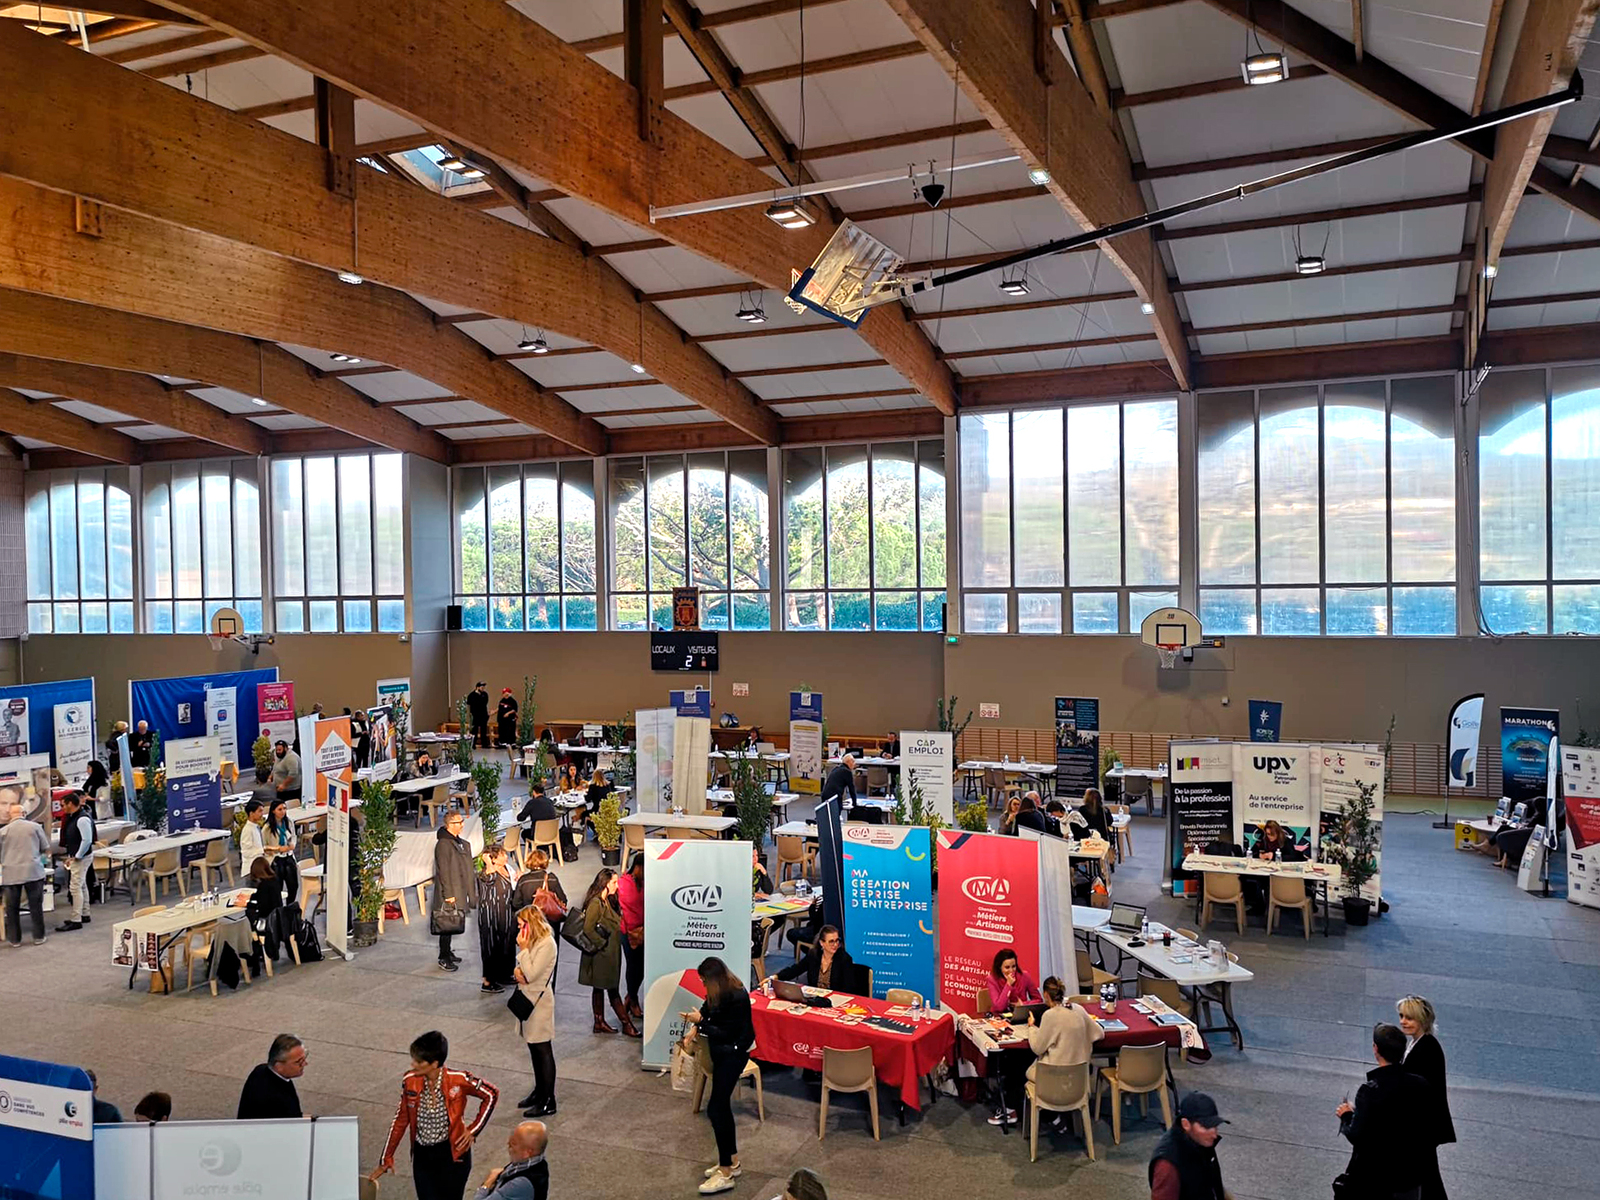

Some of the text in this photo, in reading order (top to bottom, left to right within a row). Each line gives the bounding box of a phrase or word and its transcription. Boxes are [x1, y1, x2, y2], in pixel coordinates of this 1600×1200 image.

[652, 645, 717, 654] LOCAUX VISITEURS
[685, 655, 693, 667] 2
[1504, 717, 1547, 726] MARATHON
[916, 739, 936, 747] CAP
[908, 747, 944, 755] EMPLOI
[1190, 788, 1212, 796] passion
[1181, 795, 1189, 803] la
[1190, 794, 1230, 804] profession
[1261, 802, 1304, 811] l'entreprise
[851, 869, 868, 878] MA
[851, 879, 910, 890] CREATION
[852, 889, 901, 899] REPRISE
[961, 876, 1012, 906] CMA
[670, 884, 724, 913] CMA
[852, 899, 927, 911] D'ENTREPRISE
[977, 912, 1007, 922] Métiers
[687, 921, 718, 929] Métiers
[976, 920, 1013, 932] Artisanat
[685, 930, 725, 938] Artisanat
[955, 956, 981, 967] RÉSEAU
[960, 966, 991, 976] ARTISAN
[966, 977, 987, 986] NOUV
[957, 990, 976, 999] PROX
